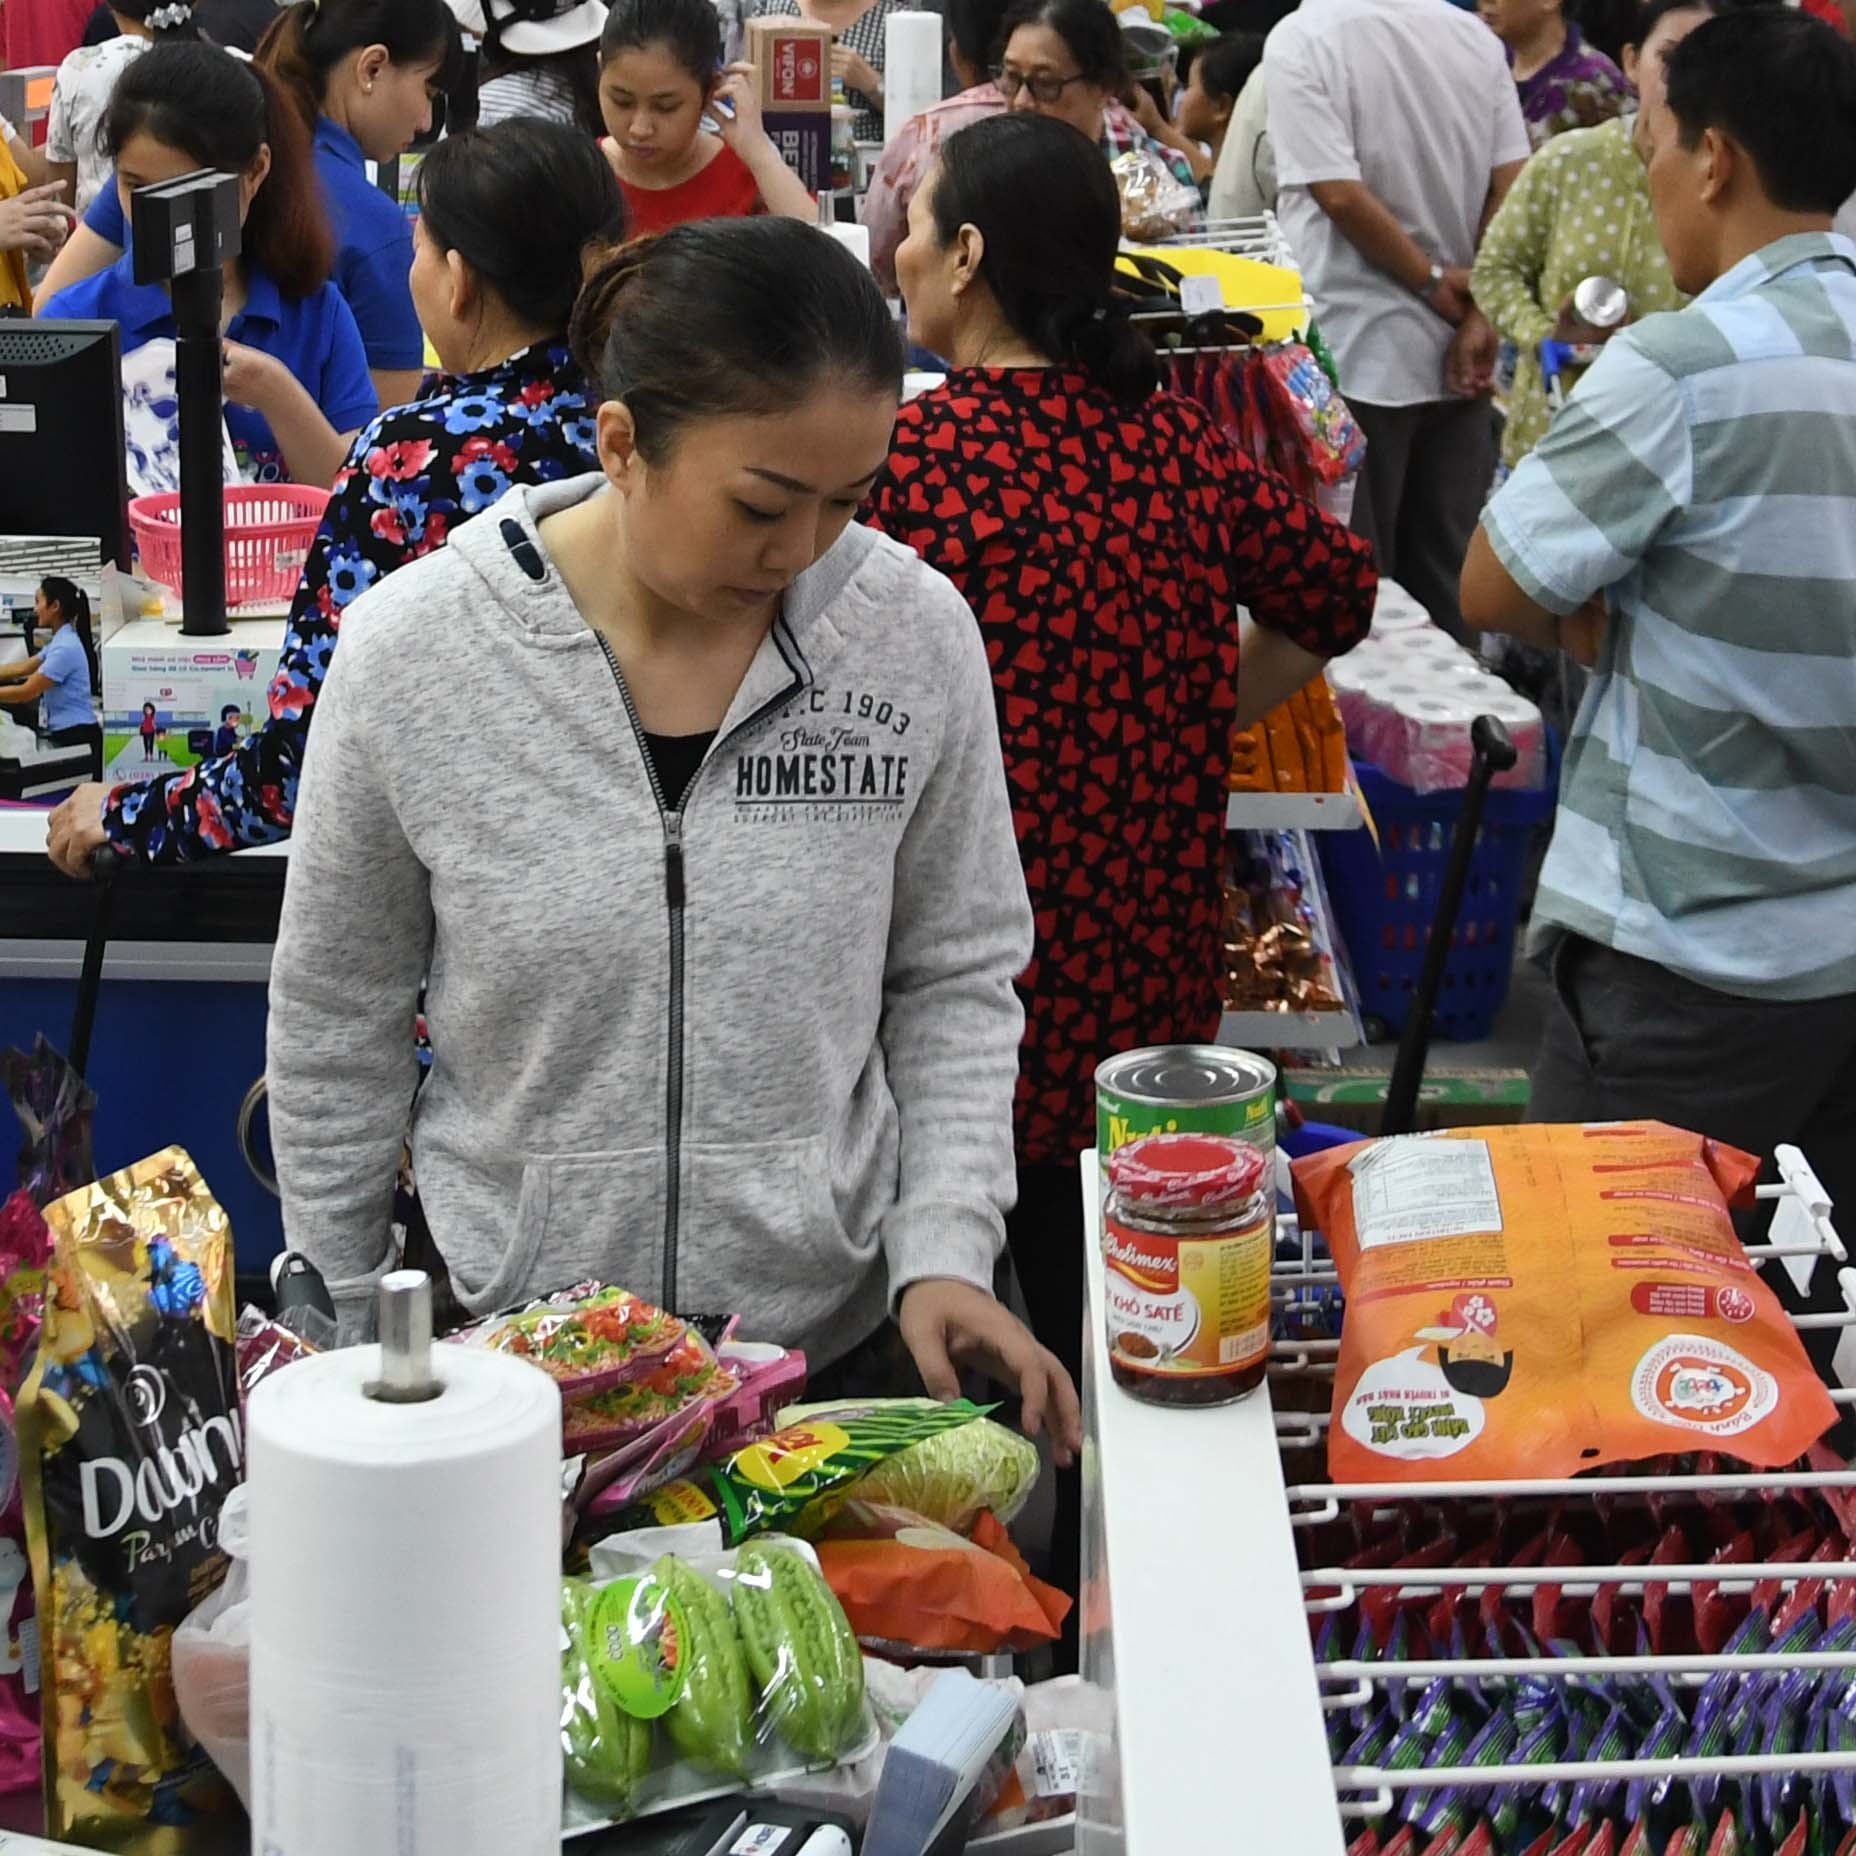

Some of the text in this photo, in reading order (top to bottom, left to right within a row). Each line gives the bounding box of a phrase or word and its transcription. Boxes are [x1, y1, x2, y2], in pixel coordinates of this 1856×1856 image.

[843, 690, 911, 736] 1903
[780, 725, 870, 753] State Team
[736, 753, 909, 797] HOMESTATE
[1104, 1231, 1177, 1273] Cholimex
